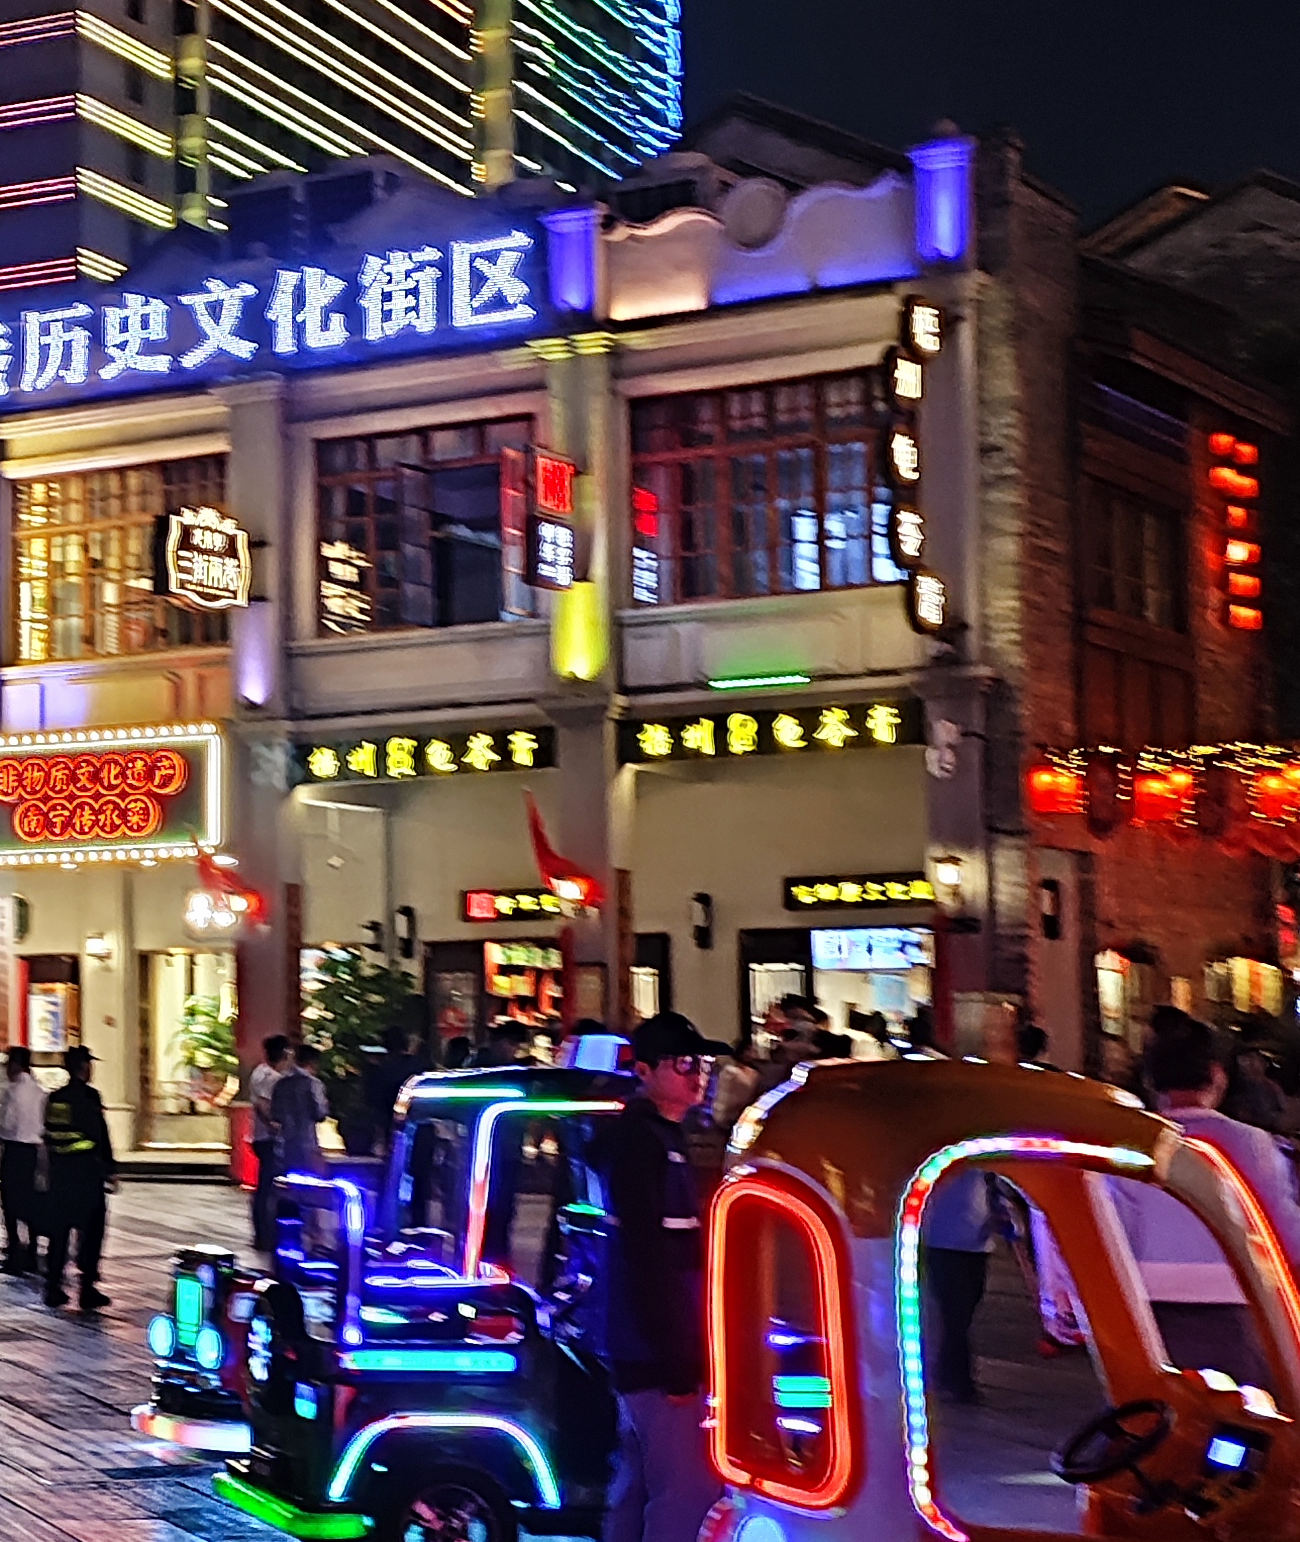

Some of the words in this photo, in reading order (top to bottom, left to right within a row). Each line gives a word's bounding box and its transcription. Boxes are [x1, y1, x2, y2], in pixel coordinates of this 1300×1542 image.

[22, 801, 147, 834] 南宁传承菜
